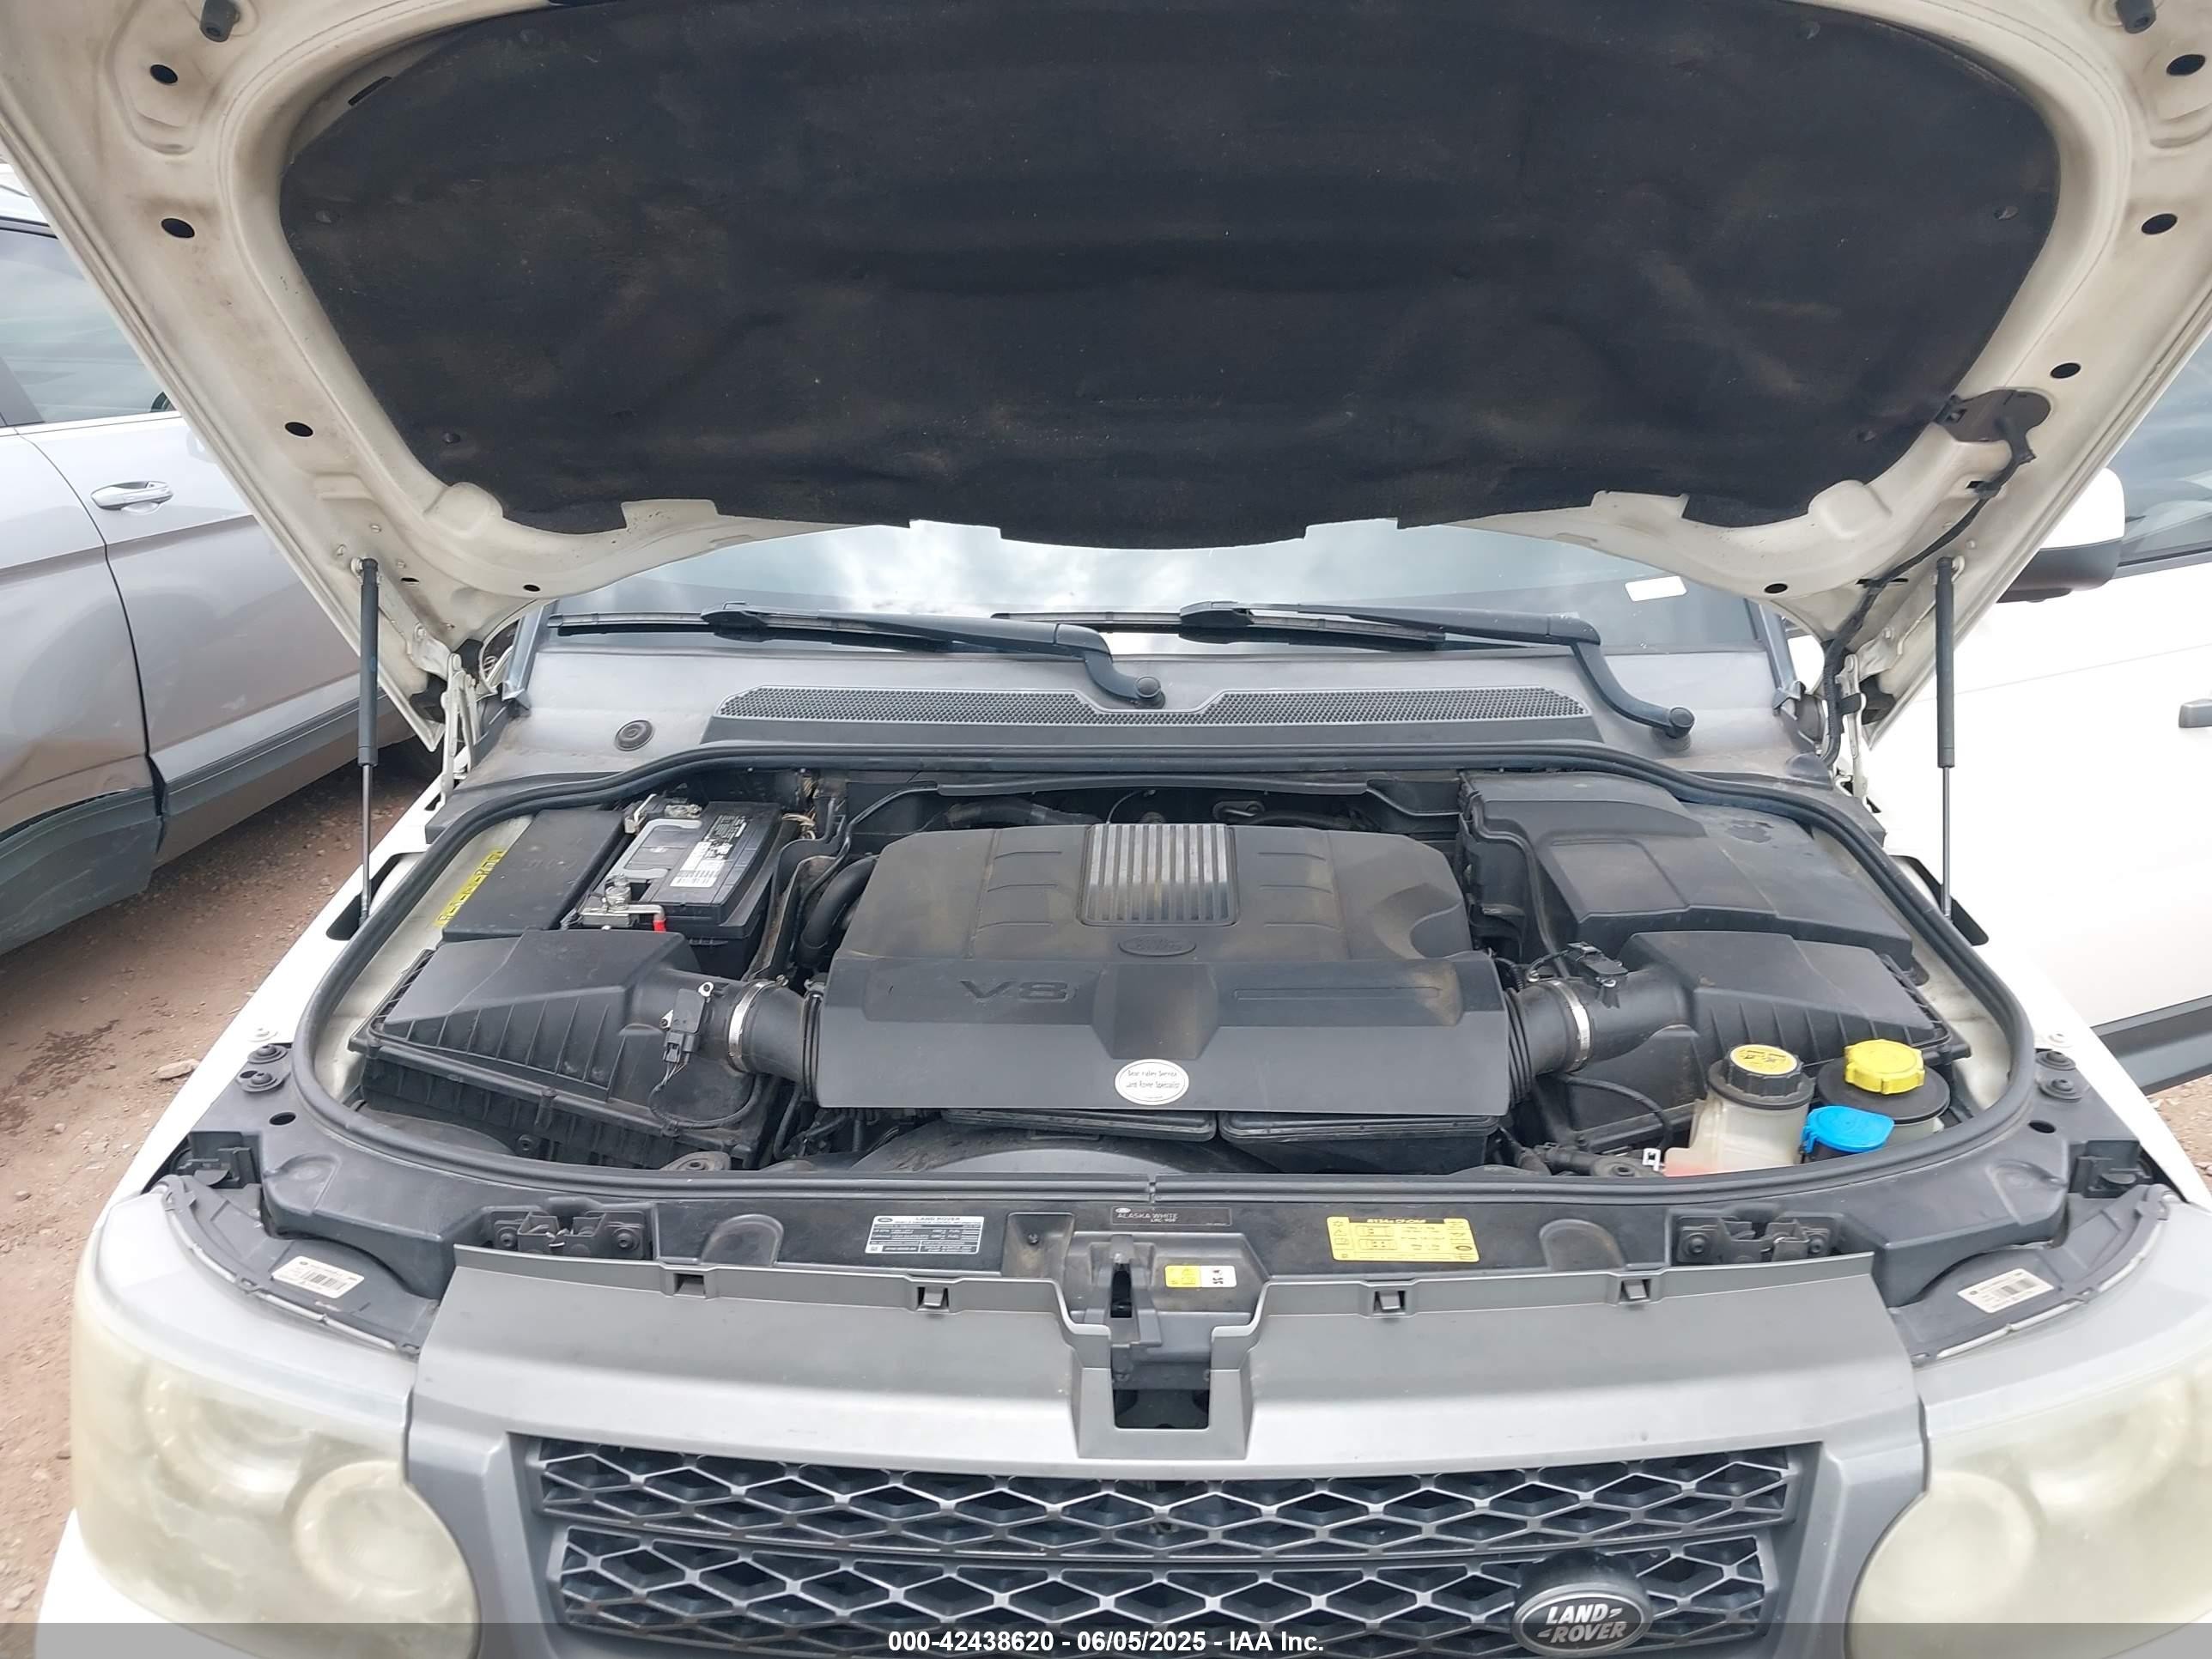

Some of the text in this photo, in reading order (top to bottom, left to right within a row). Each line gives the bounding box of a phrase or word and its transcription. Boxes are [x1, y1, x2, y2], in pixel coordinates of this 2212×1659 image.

[959, 980, 1068, 1000] V8
[1546, 1603, 1609, 1625] LAND
[1550, 1621, 1628, 1644] ROVER
